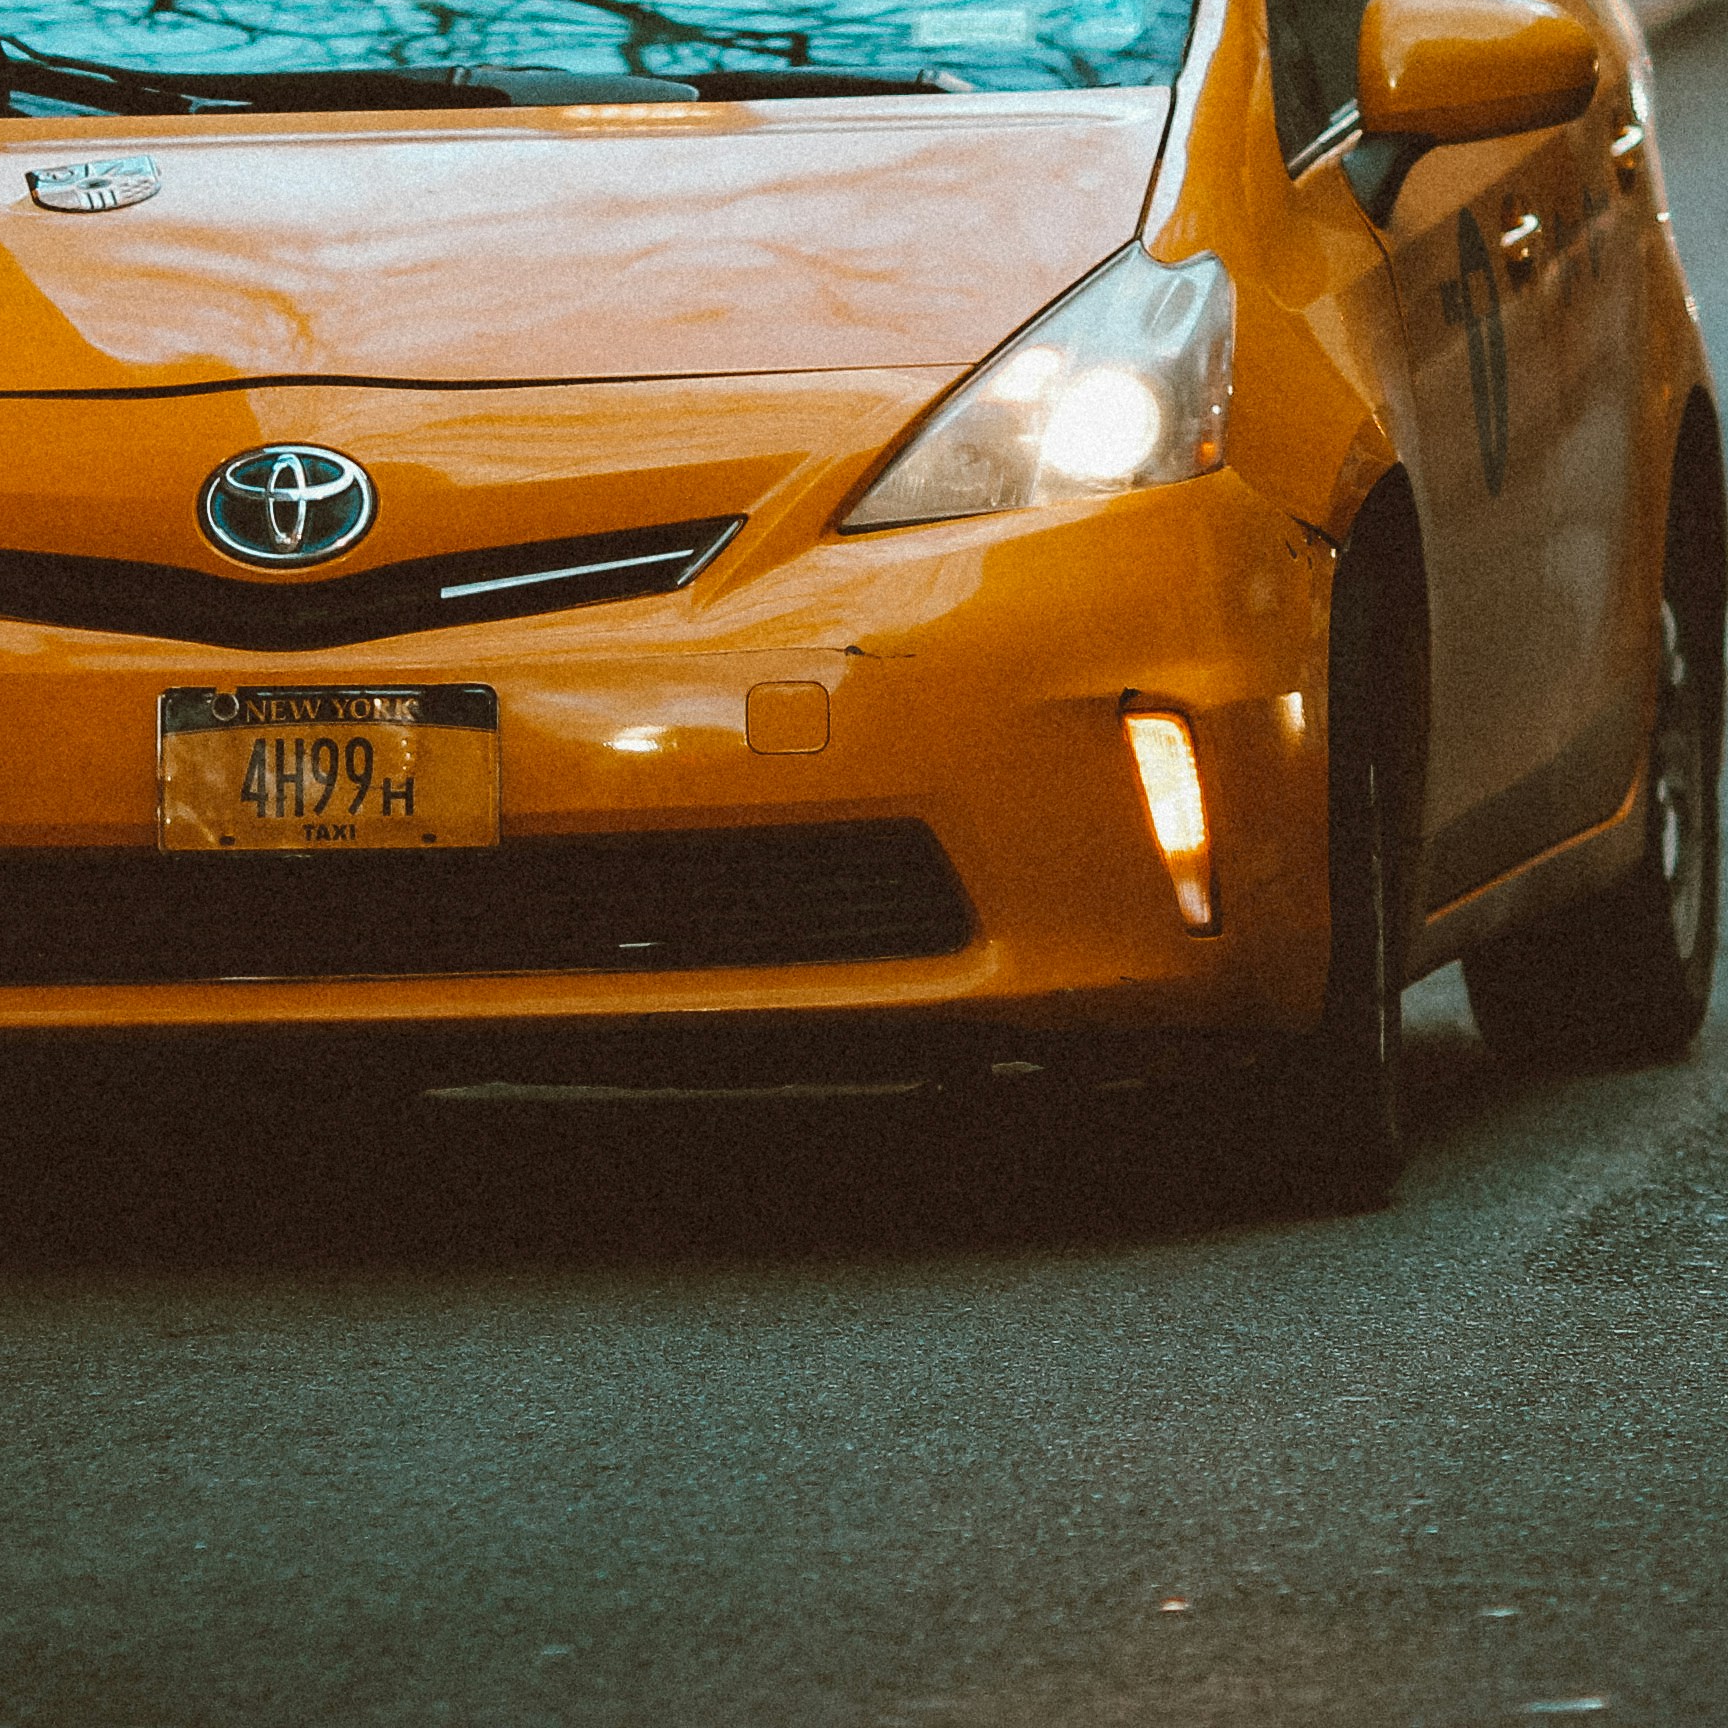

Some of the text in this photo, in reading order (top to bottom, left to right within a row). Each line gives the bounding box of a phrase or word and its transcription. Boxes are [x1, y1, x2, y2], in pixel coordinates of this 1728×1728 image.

[245, 697, 421, 722] NEW YORK
[303, 823, 357, 841] TAXI
